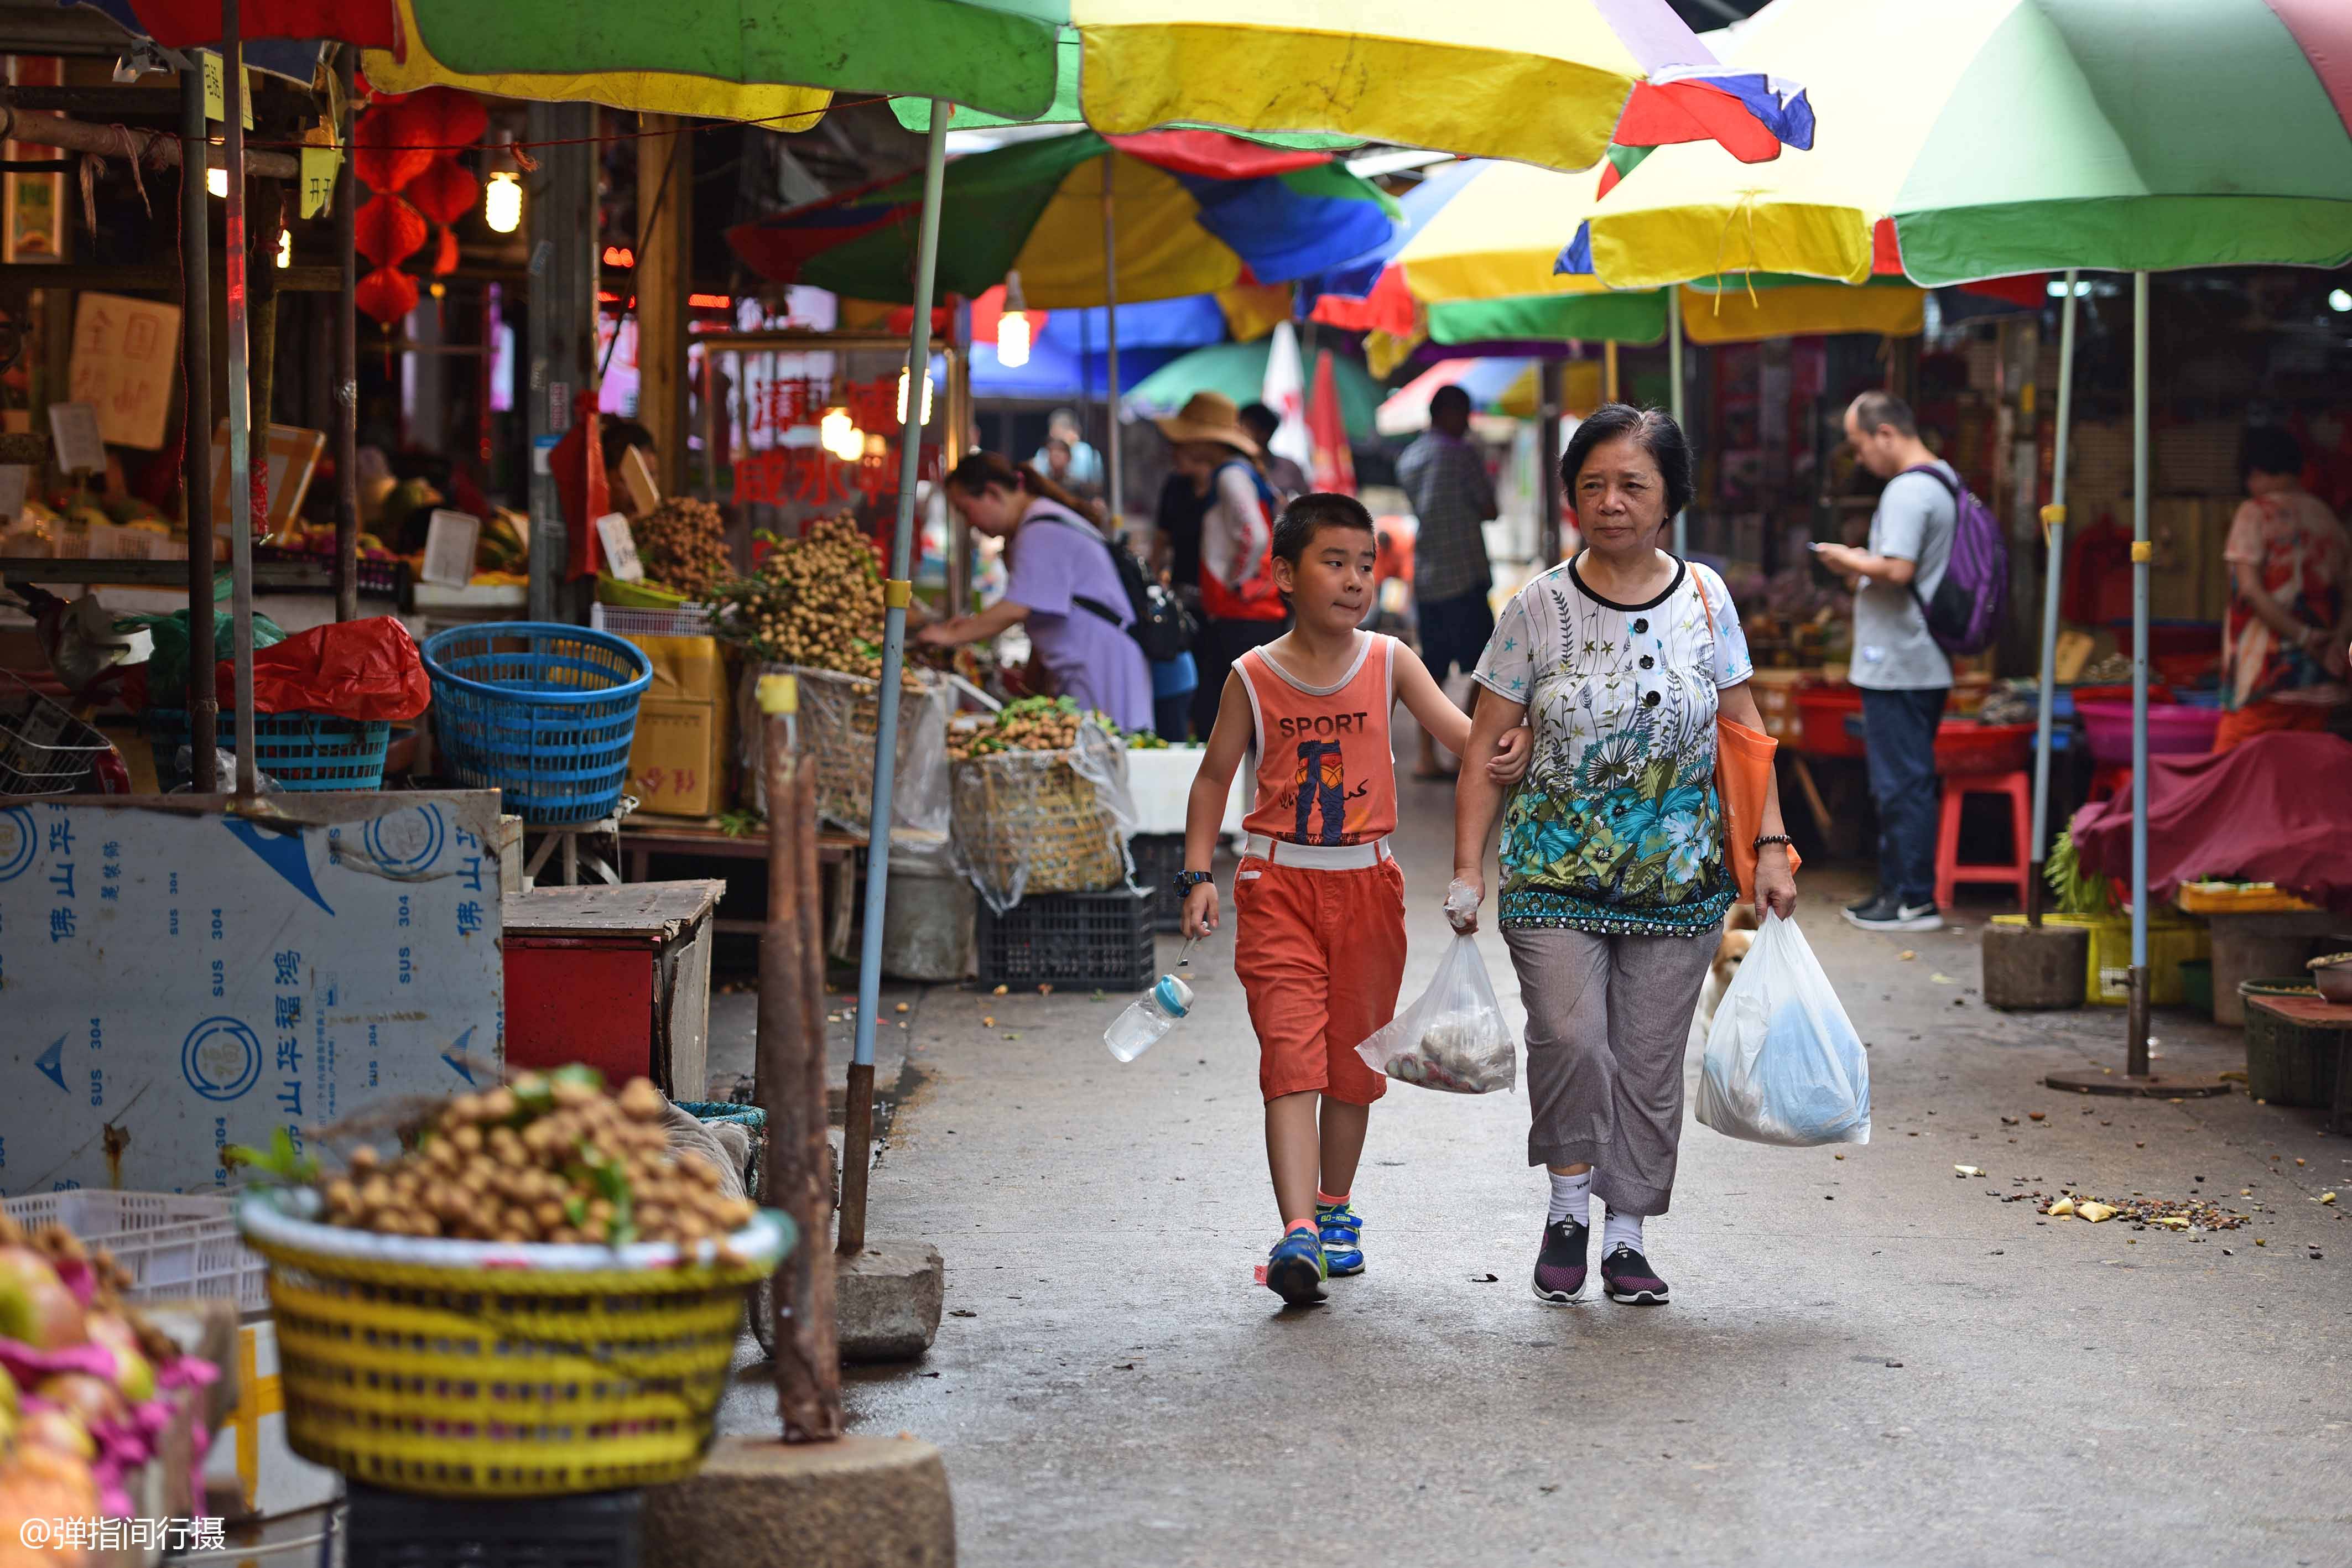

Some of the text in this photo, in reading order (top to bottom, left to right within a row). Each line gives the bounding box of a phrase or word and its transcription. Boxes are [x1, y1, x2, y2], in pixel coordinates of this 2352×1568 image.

[1279, 712, 1367, 737] SPORT
[329, 827, 341, 865] SS
[169, 872, 178, 935] SUS 304
[211, 908, 224, 997] SUS 304
[398, 894, 411, 984] SUS 304
[90, 1017, 102, 1106] SUS 304
[369, 1060, 378, 1087] SUS
[215, 1117, 226, 1149] 304
